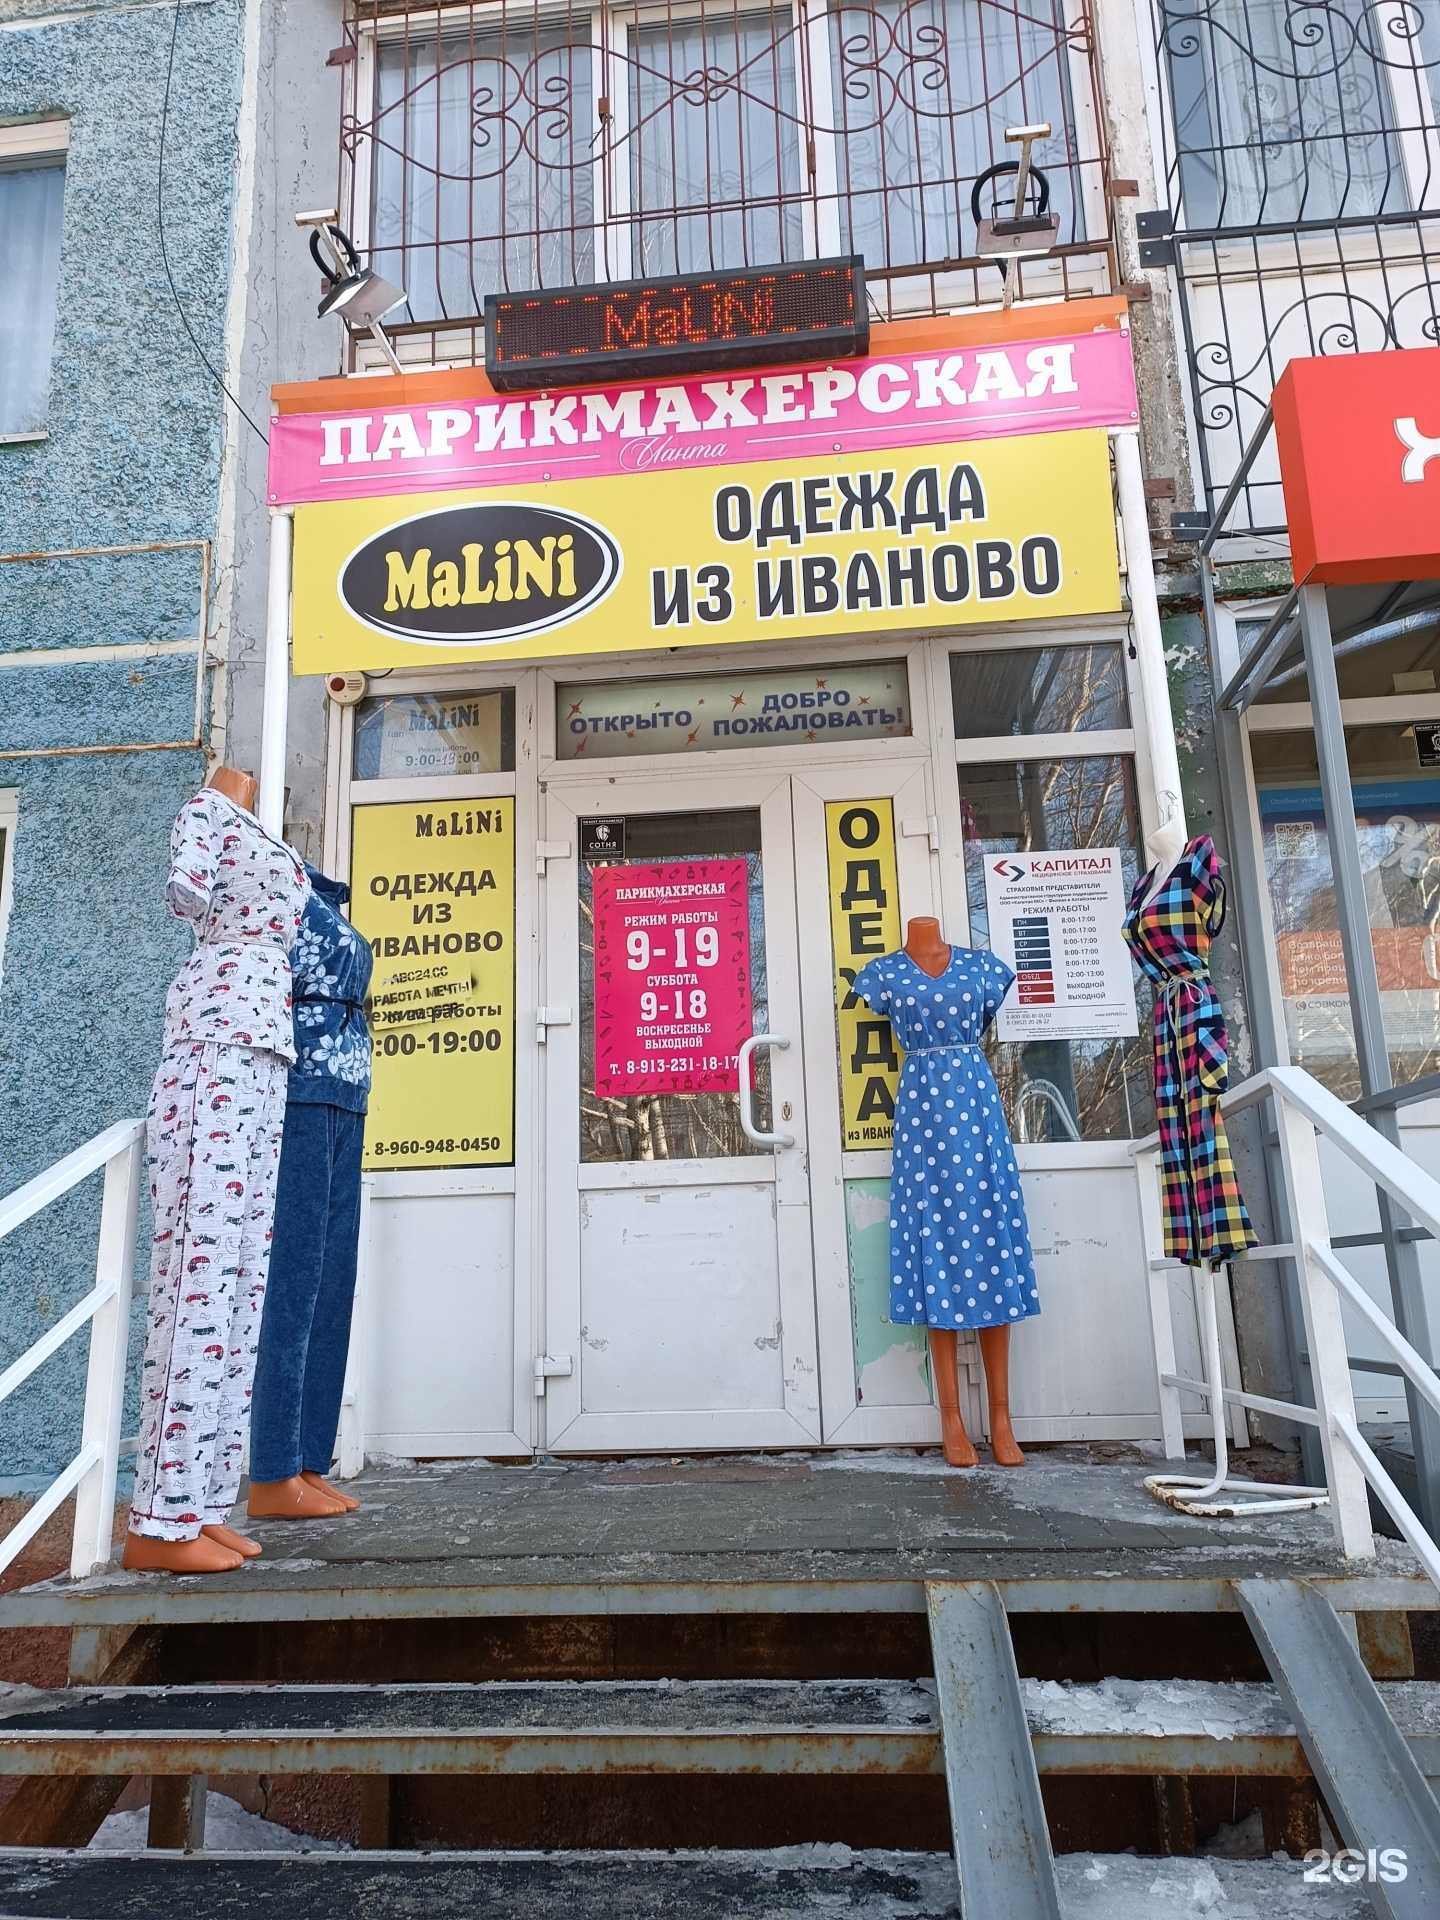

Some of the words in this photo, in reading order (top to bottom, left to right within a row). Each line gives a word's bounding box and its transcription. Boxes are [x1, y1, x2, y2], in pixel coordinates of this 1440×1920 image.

[319, 343, 1079, 466] ПАРИКМАХЕРСКАЯ
[715, 463, 986, 549] ОДЕЖДА
[382, 534, 577, 612] MaLiNi
[652, 564, 733, 627] ИЗ
[756, 536, 1060, 618] ИВАНОВО
[761, 689, 851, 714] ДОБРО
[569, 710, 693, 735] ОТКРЫТО
[712, 706, 904, 738] ПОЖАЛОВАТЬ!
[415, 809, 503, 838] MaLiNi
[1031, 857, 1112, 873] КАПИТАЛ
[369, 869, 497, 901] ОДЕЖДА
[615, 882, 726, 900] ПАРИКМАХЕРСКАЯ
[1006, 884, 1044, 893] СТРАХОВЫЕ
[1045, 882, 1101, 892] ПРЕДСТАВИТЕЛИ
[412, 902, 452, 925] ИЗ
[624, 914, 668, 928] РЕЖИМ
[671, 911, 719, 925] РАБОТЫ
[1023, 906, 1054, 915] РЕЖИМ
[1056, 905, 1090, 914] РАБОТЫ
[626, 926, 719, 971] 9-19
[646, 973, 699, 987] СУББОТА
[640, 989, 708, 1022] 9-18
[636, 1022, 712, 1037] ВОСКРЕСЕНЬЕ
[371, 1028, 502, 1057] :00-19:00
[645, 1035, 704, 1050] ВЫХОДНОЙ
[626, 1055, 739, 1075] 8-913-231-18-17
[374, 1136, 501, 1156] 8-960-948-0450
[847, 1131, 860, 1141] из
